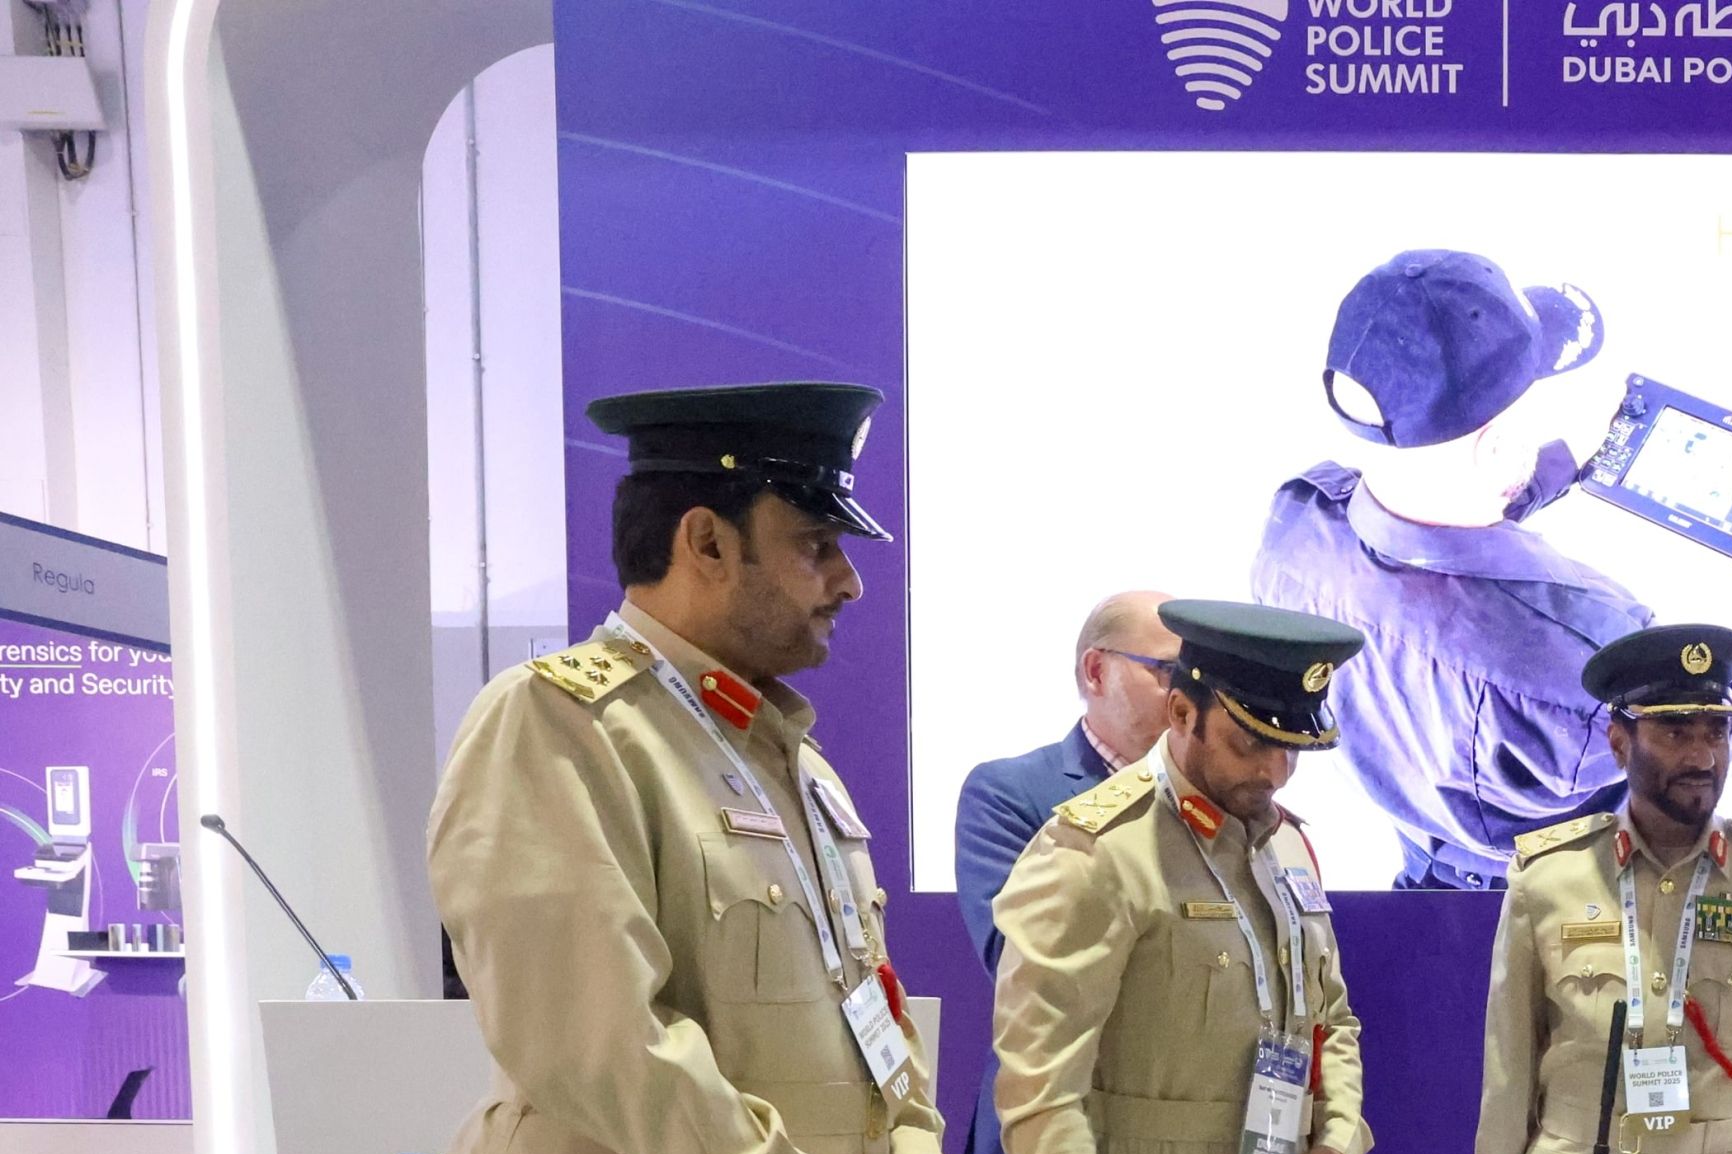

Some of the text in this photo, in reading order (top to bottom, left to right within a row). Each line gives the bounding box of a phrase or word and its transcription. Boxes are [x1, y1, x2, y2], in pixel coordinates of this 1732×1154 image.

[1307, 0, 1452, 18] WORLD
[1563, 1, 1667, 48] دبي
[1307, 25, 1444, 56] POLICE
[1305, 63, 1464, 94] SUMMIT
[1563, 56, 1672, 83] DUBAI
[32, 562, 96, 595] Regula
[88, 640, 122, 662] for
[29, 673, 74, 694] and
[81, 673, 174, 700] Security
[890, 1071, 909, 1100] VIP
[1629, 1069, 1683, 1080] WORLD POLICE
[1632, 1077, 1681, 1087] SUMMIT 2025
[1644, 1115, 1675, 1131] VIP
